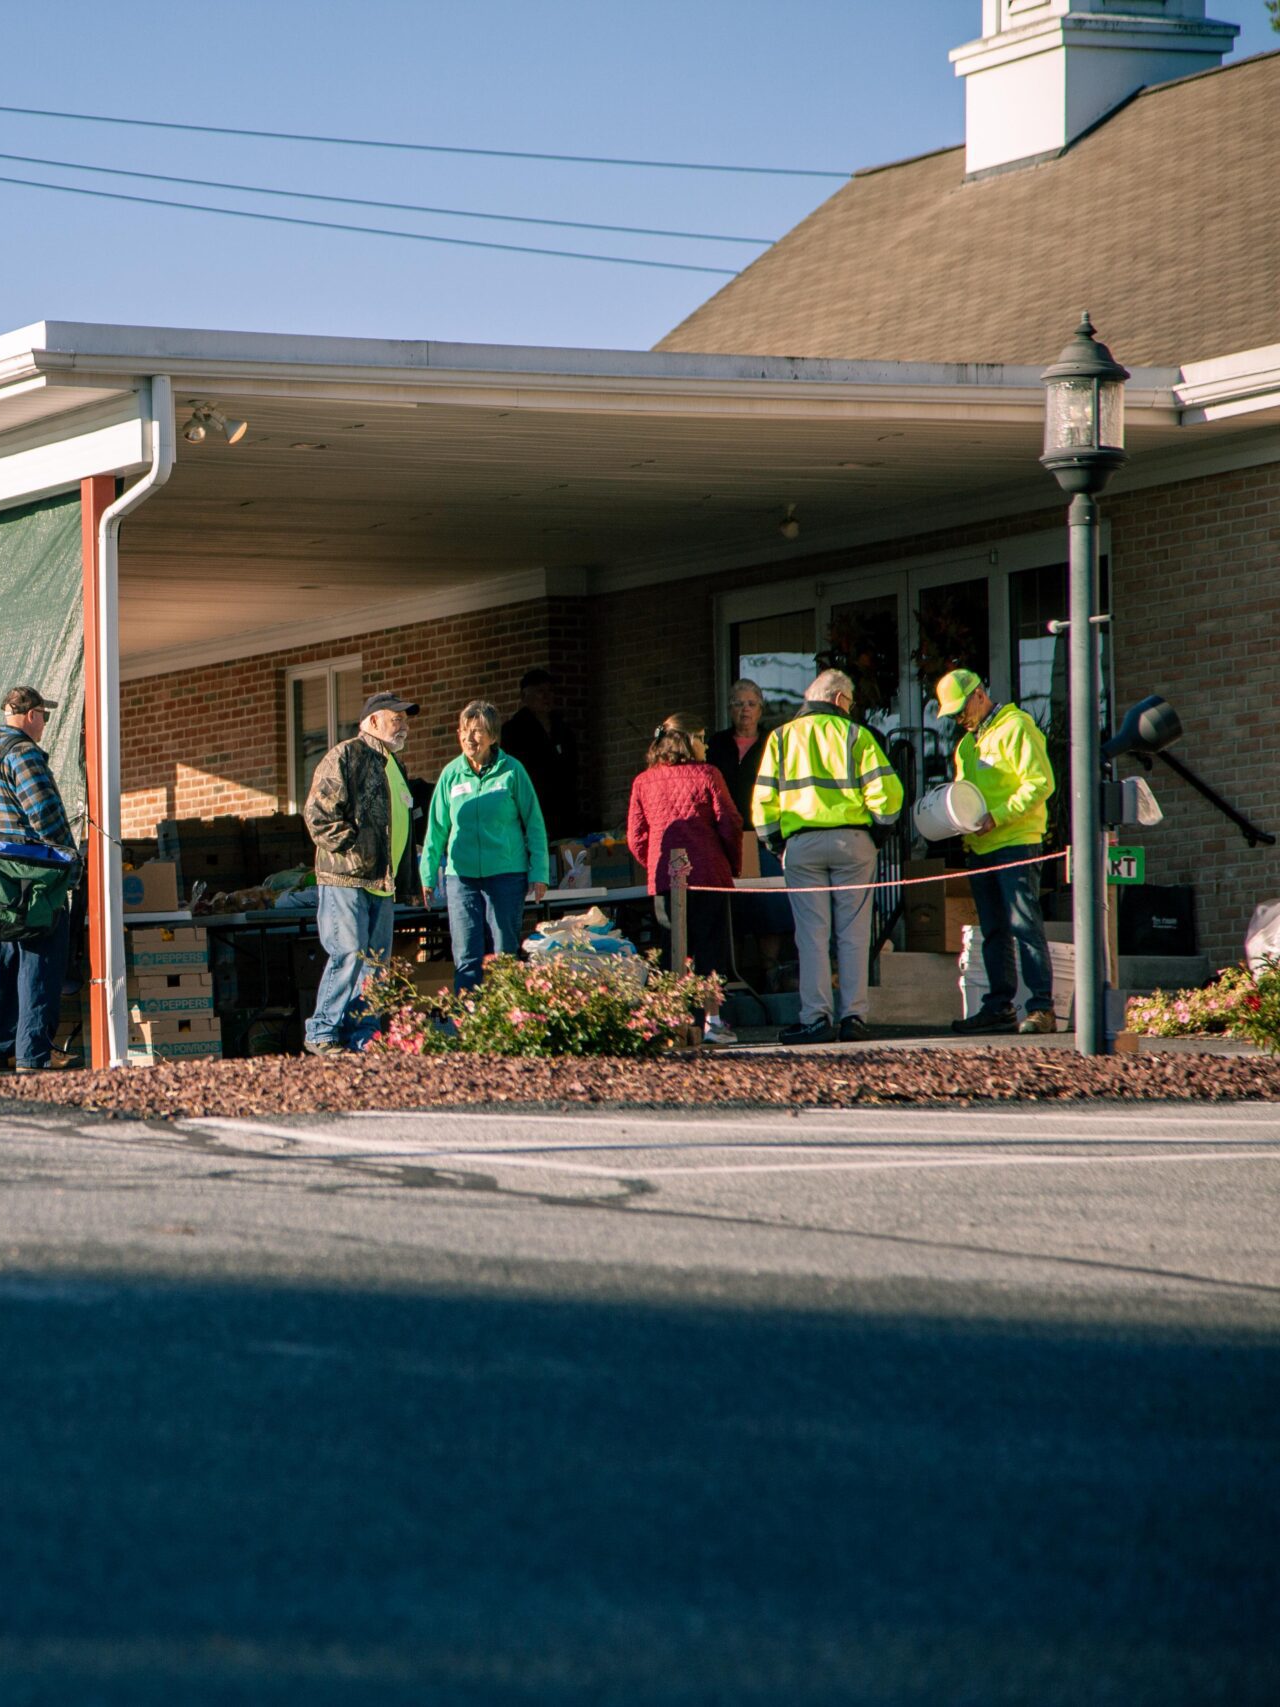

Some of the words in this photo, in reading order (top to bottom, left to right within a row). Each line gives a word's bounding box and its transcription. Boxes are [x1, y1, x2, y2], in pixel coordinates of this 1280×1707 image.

[1107, 857, 1136, 877] RT
[155, 952, 203, 963] PEPPERS
[162, 998, 209, 1009] PEPPERS
